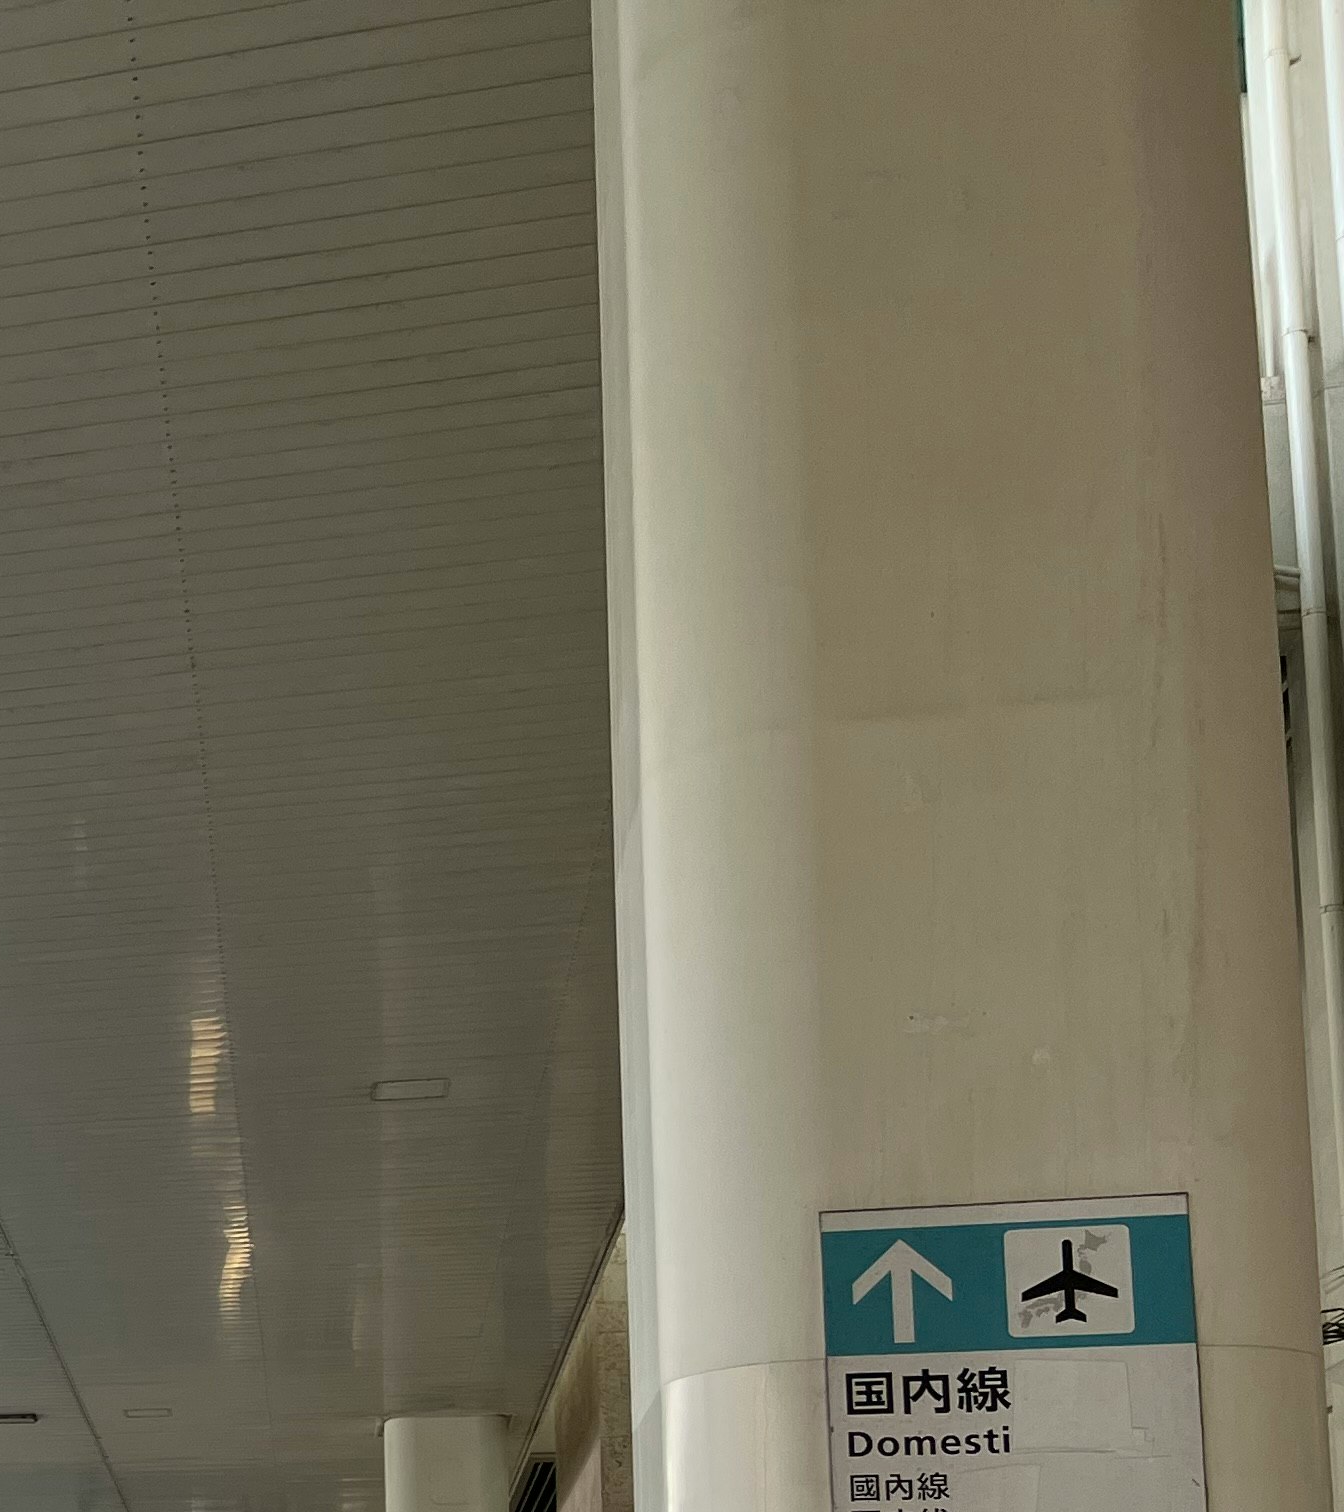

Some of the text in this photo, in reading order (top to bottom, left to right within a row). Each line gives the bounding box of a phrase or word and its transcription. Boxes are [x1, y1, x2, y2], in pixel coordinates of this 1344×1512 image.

[845, 1366, 1012, 1415] 国内線
[848, 1426, 1011, 1458] Domesti
[850, 1473, 950, 1502] 國內線
